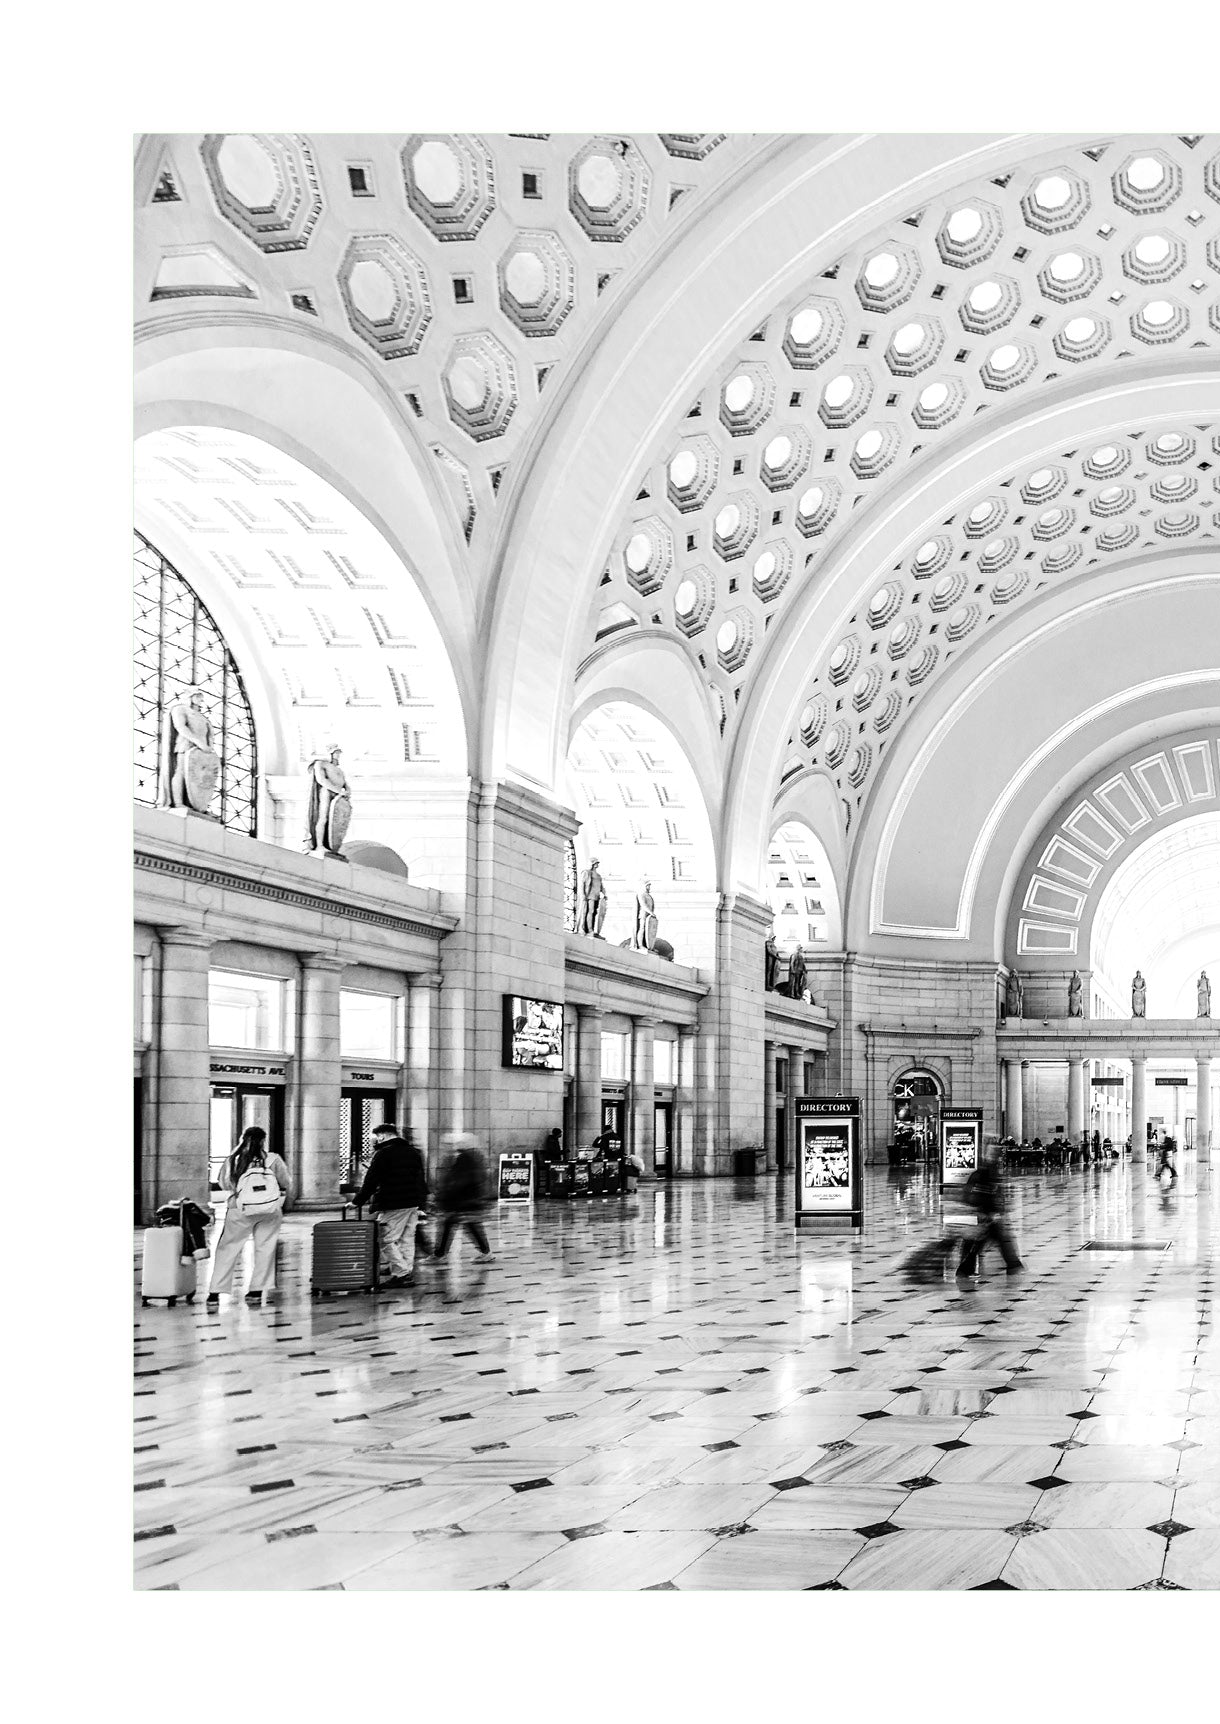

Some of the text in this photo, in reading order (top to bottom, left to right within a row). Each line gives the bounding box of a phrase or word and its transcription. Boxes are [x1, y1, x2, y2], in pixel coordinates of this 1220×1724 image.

[351, 1072, 375, 1081] TOURS
[800, 1103, 852, 1112] DIRECTORY
[502, 1172, 529, 1180] HERE
